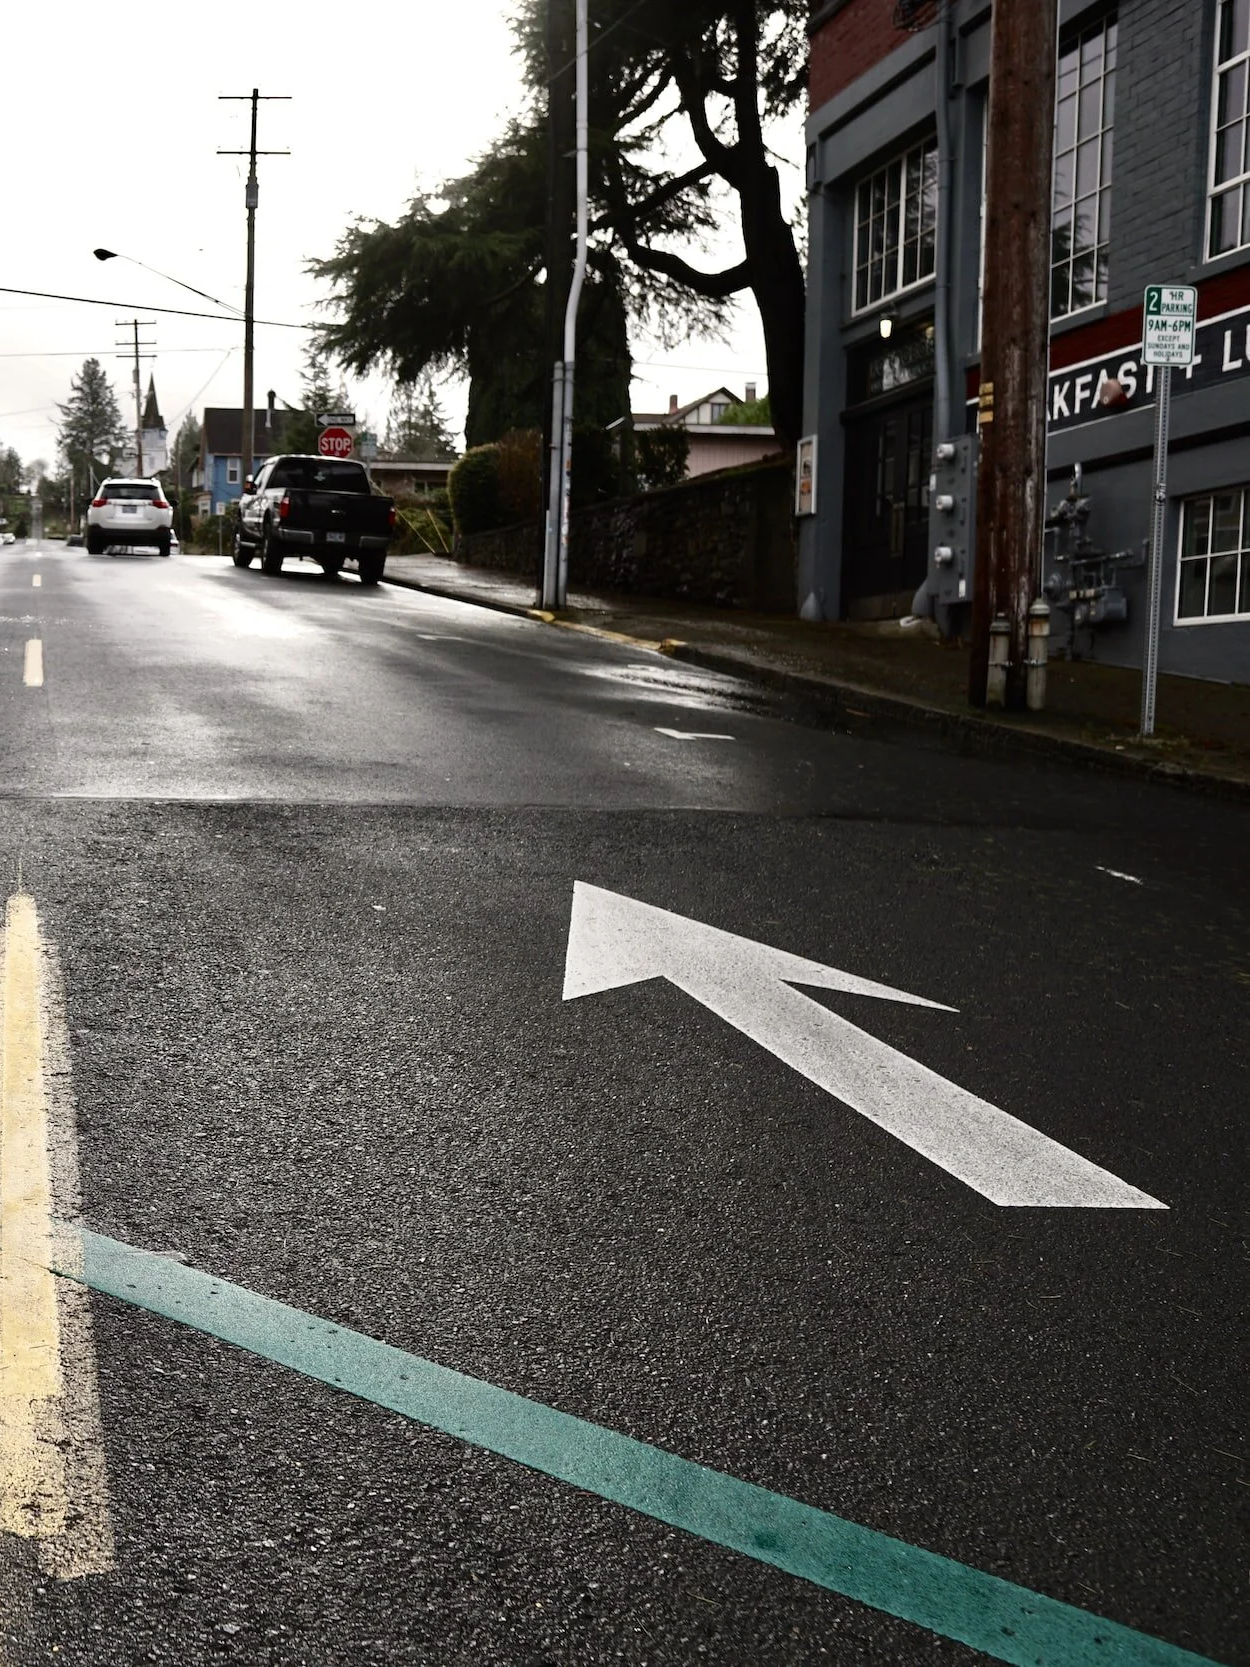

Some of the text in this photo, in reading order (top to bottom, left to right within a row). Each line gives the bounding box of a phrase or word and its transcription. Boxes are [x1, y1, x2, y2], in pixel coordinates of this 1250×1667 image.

[1149, 291, 1184, 312] 2 HR
[1161, 303, 1193, 313] PARKING
[1148, 319, 1191, 332] 9AM-6PM
[1222, 324, 1250, 372] L
[321, 437, 351, 451] STOP
